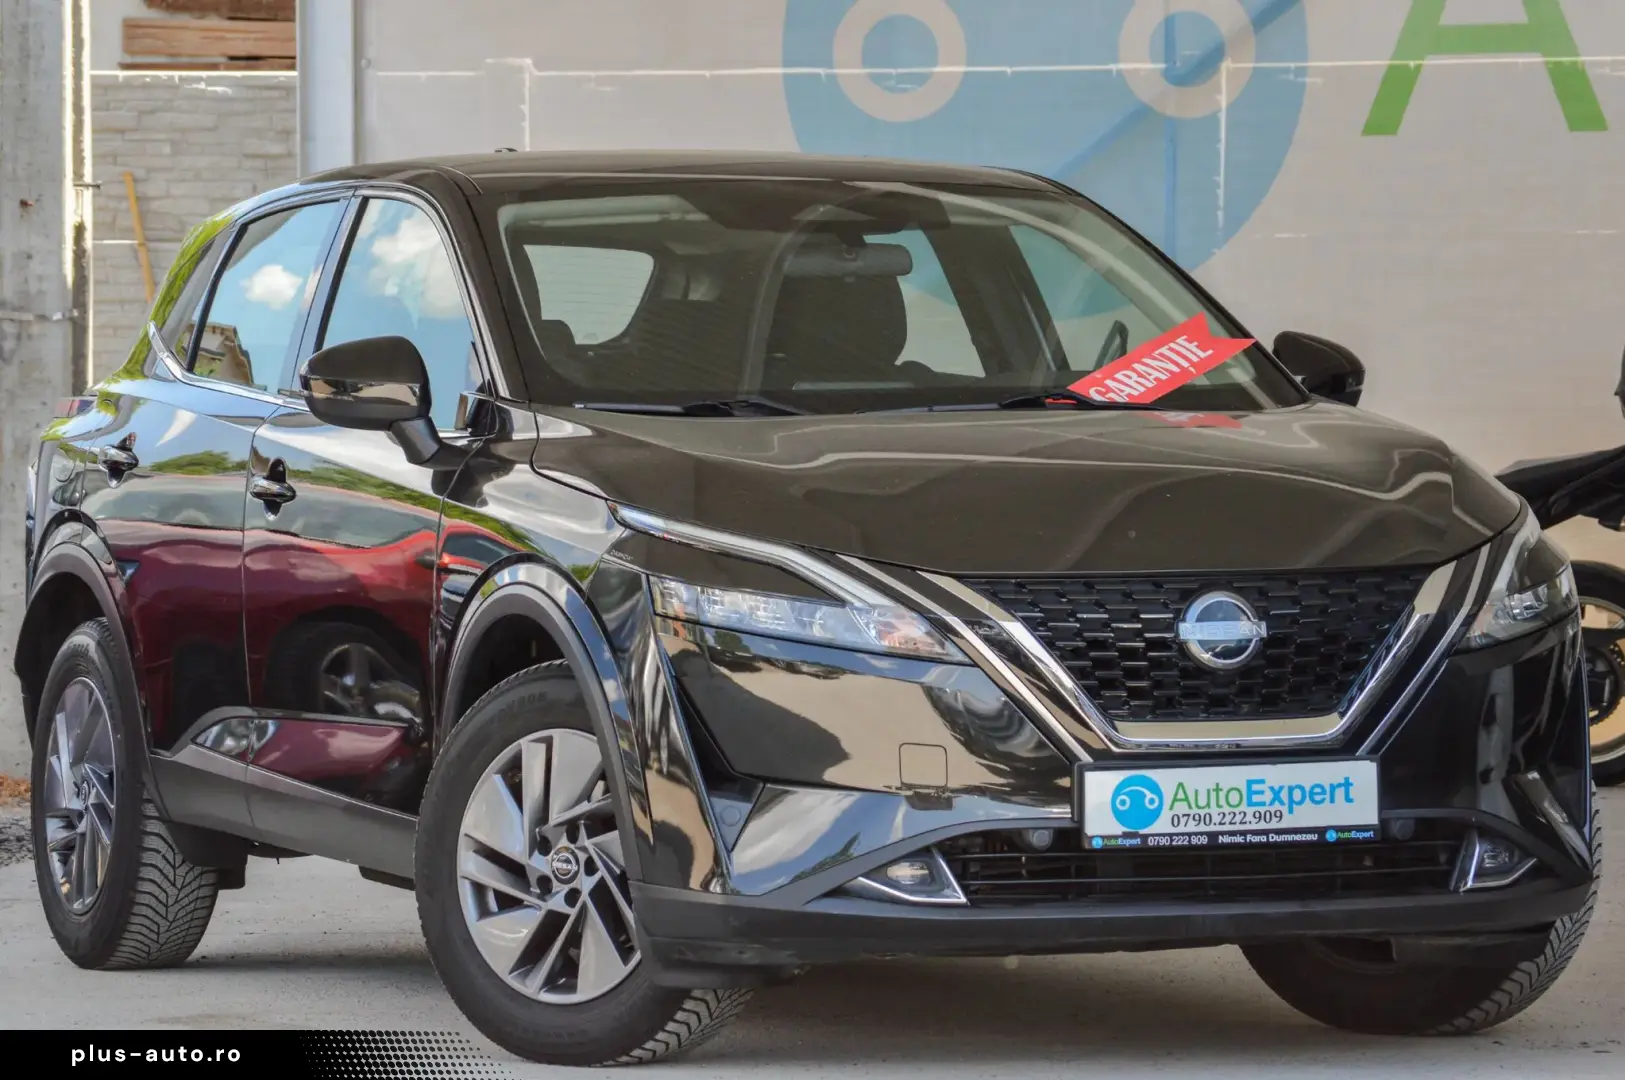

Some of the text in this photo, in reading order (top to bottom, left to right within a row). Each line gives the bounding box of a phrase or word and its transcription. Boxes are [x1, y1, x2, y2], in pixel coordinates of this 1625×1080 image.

[1169, 776, 1354, 814] AutoExpert
[1171, 809, 1284, 828] 0790.222.909
[1103, 830, 1374, 846] AutoExpert 0790 222 909 Nimic Fara Dumnezeu AutoExpert
